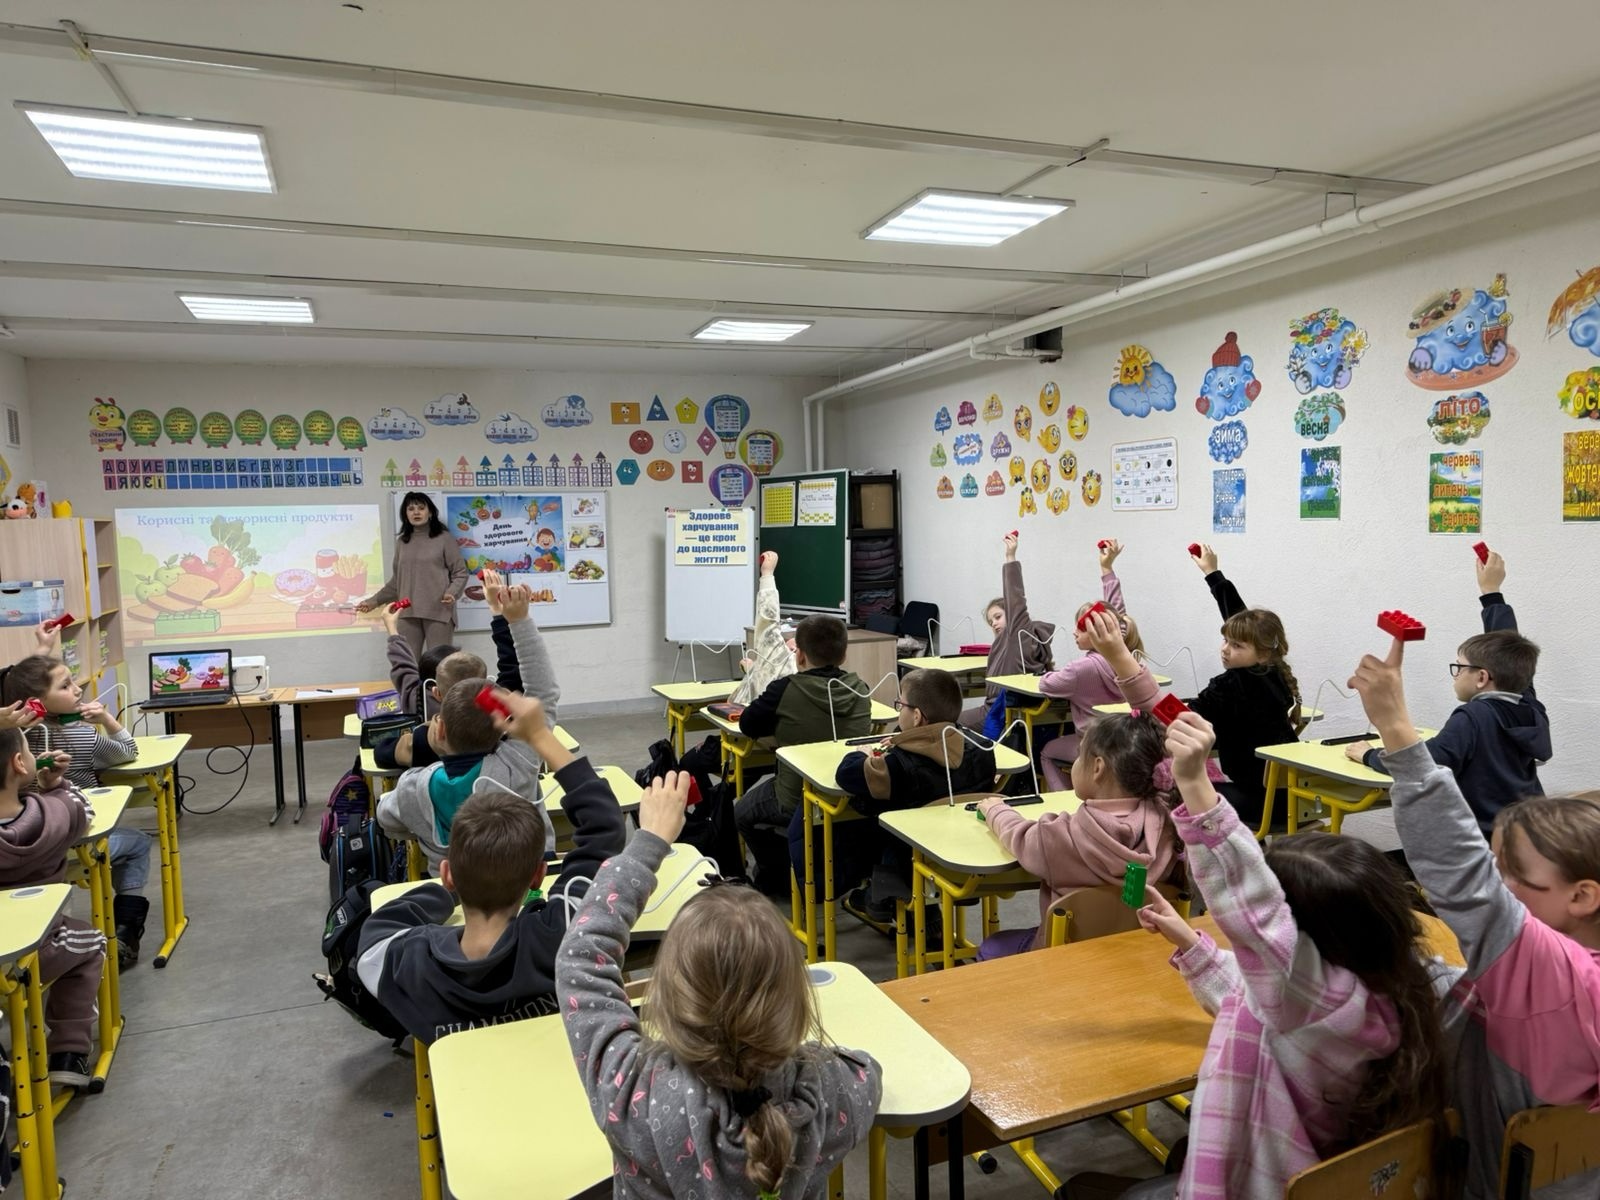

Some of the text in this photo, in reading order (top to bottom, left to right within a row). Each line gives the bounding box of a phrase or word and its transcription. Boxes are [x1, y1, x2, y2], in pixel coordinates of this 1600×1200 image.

[1438, 397, 1480, 419] літо
[1300, 422, 1329, 436] весна
[1214, 428, 1241, 444] зима
[137, 513, 194, 528] Корисні
[291, 512, 353, 525] продукти
[689, 512, 732, 521] Здорове
[492, 523, 513, 531] День
[682, 523, 739, 532] харчування
[484, 530, 524, 540] здорового
[698, 534, 711, 543] це
[712, 534, 736, 542] крок
[484, 537, 528, 547] харчування
[676, 545, 746, 554] до щасливого
[694, 555, 728, 563] життя!
